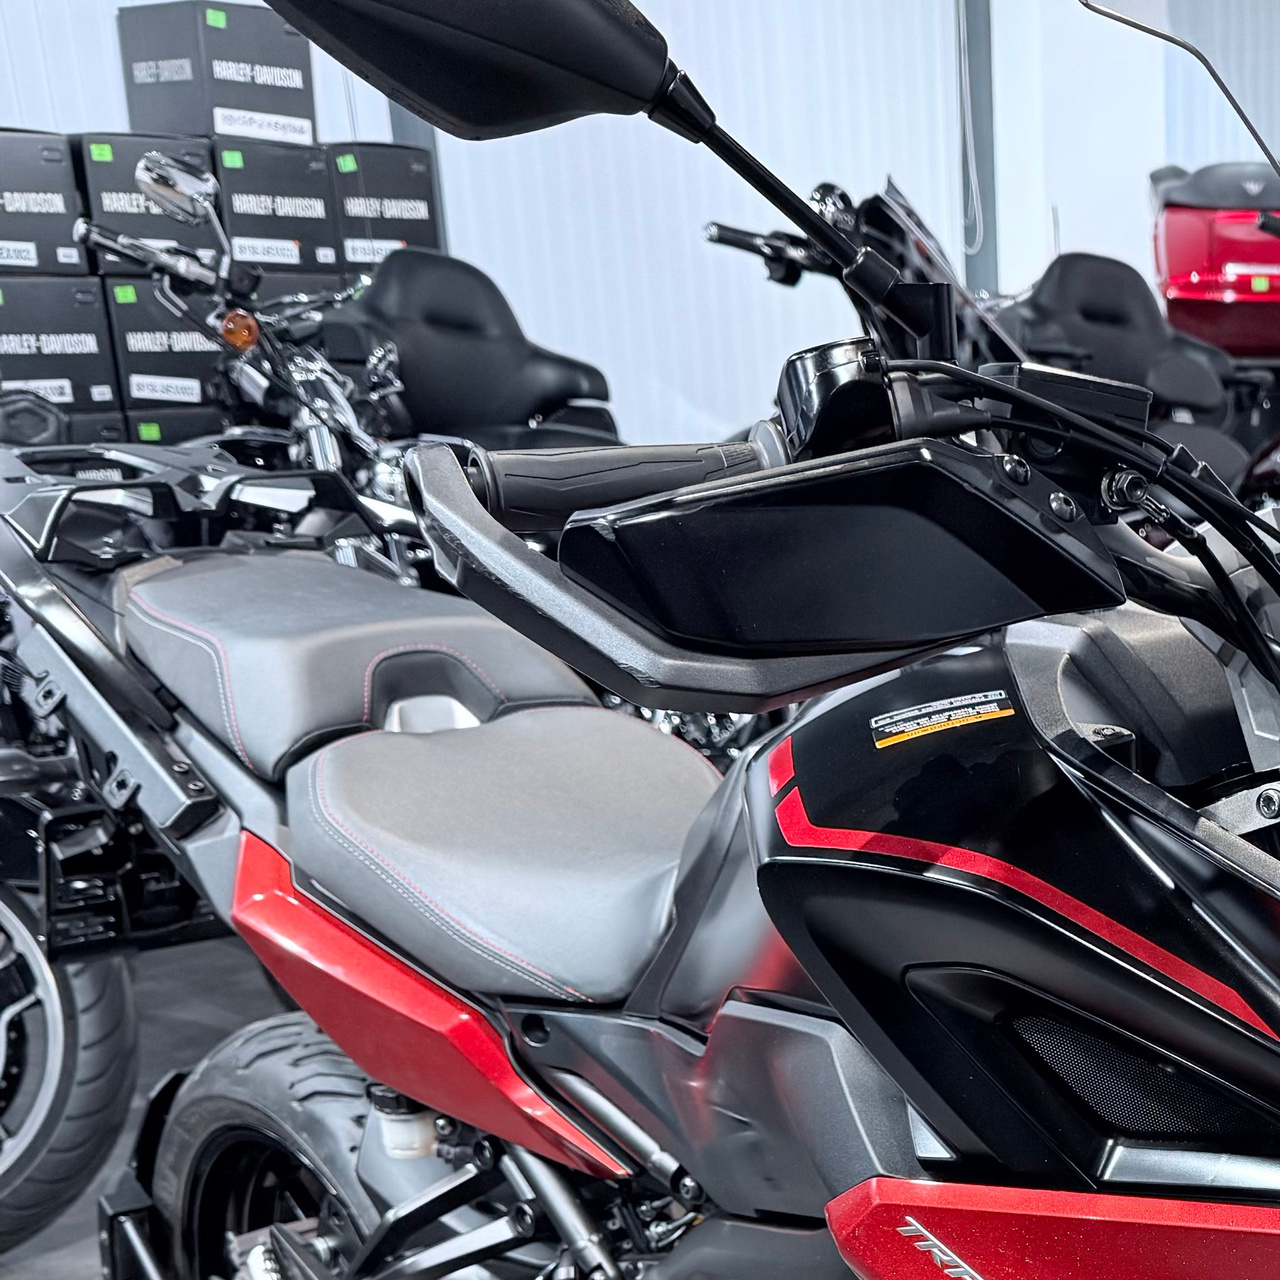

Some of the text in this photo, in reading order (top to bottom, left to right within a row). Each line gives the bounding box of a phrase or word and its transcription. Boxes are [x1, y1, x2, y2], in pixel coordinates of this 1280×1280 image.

[212, 59, 304, 89] HARLEY-DAVIDSON
[231, 193, 326, 219] HARLEY-DAVIDSON
[344, 197, 430, 220] HARLEY-DAVIDSON
